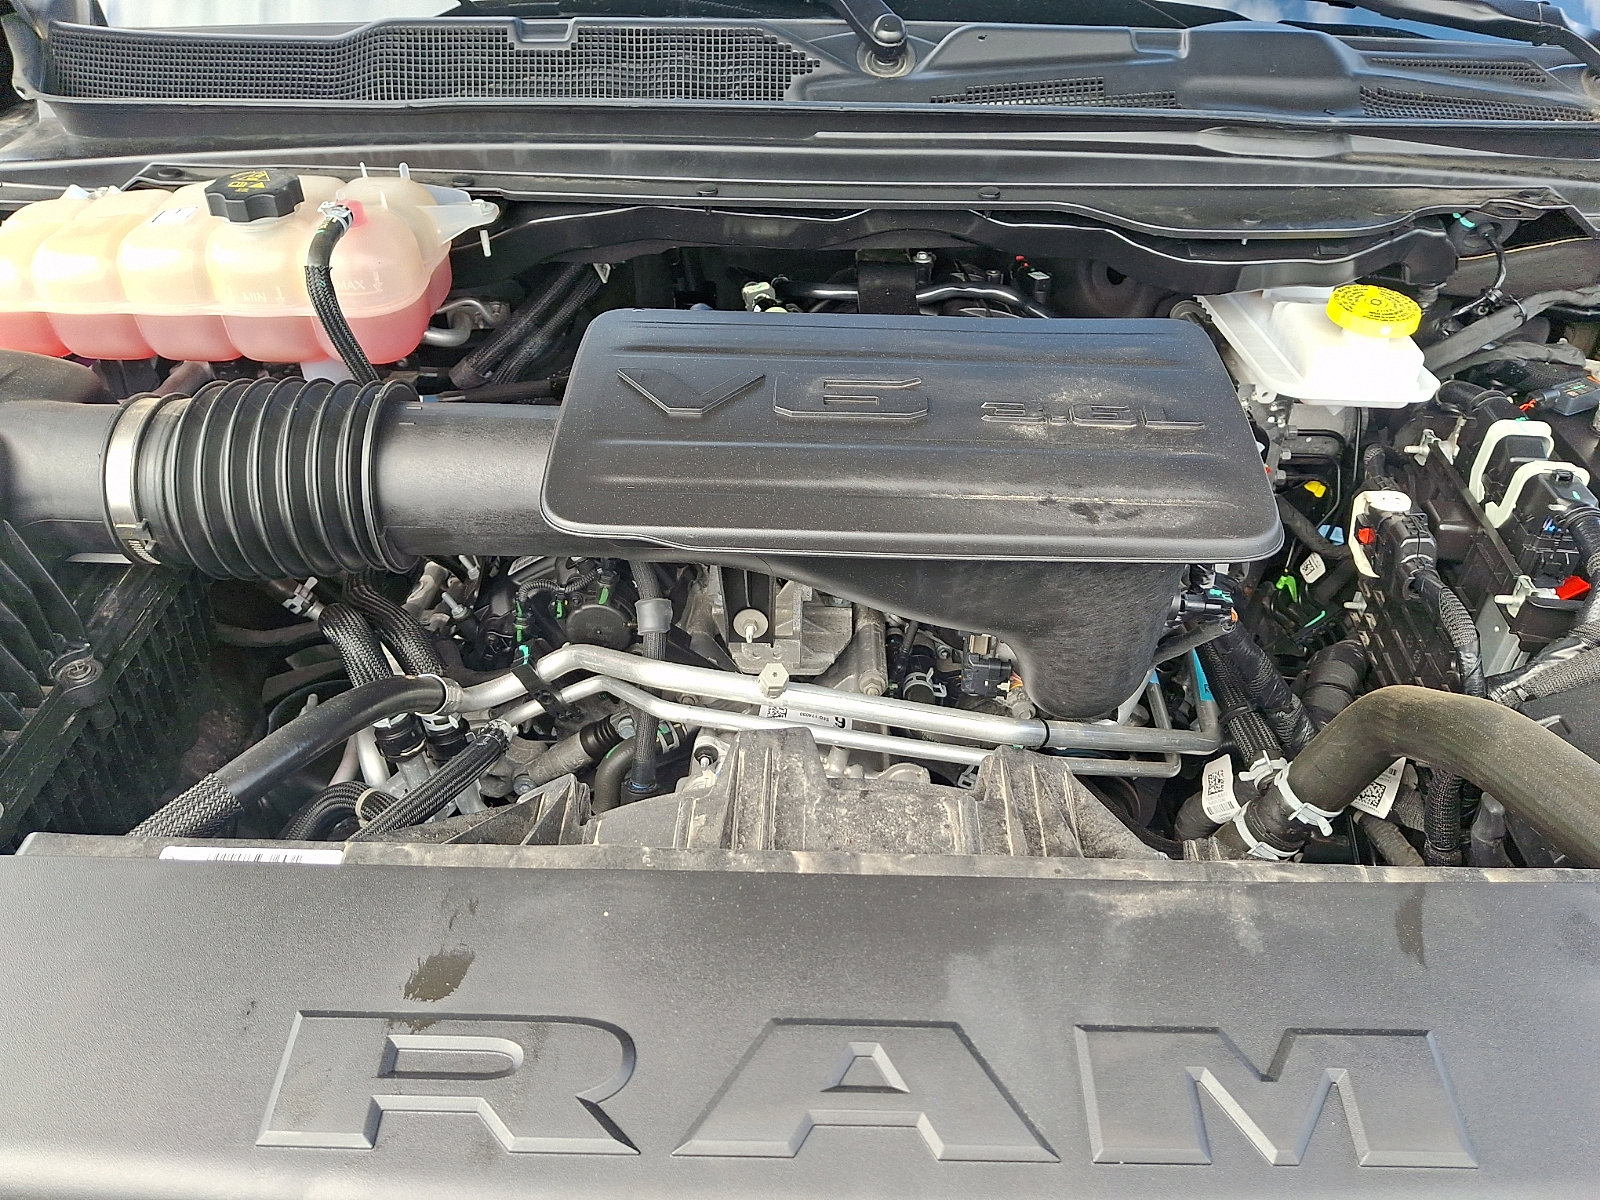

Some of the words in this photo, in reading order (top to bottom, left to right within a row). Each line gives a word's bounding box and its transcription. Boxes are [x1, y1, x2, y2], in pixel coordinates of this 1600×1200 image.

[339, 279, 366, 290] MAX
[242, 291, 267, 302] MIN
[980, 400, 1206, 430] 3.6L
[255, 1008, 1479, 1169] RAM
